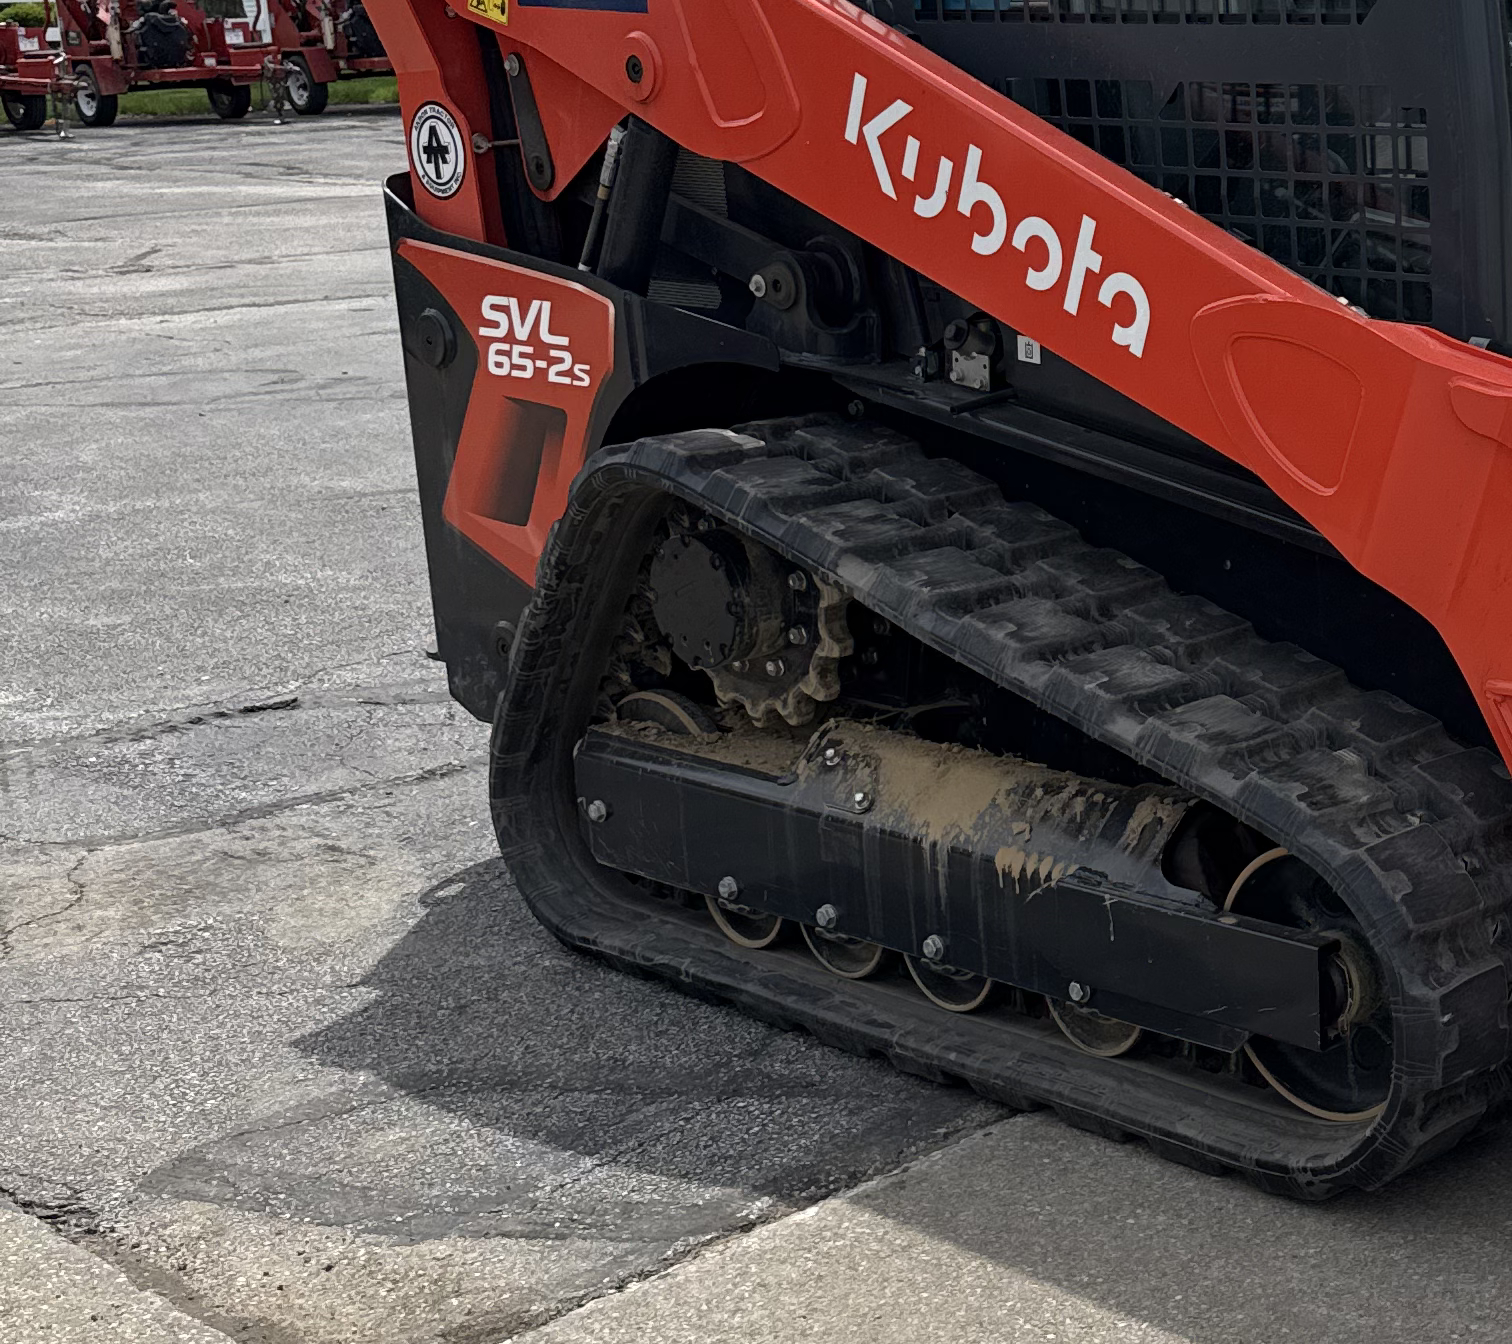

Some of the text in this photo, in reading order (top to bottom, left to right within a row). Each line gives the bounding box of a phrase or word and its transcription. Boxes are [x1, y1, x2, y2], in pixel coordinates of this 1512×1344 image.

[428, 106, 455, 130] TRACTOR
[844, 71, 1151, 359] Kubota
[478, 294, 570, 347] SVL
